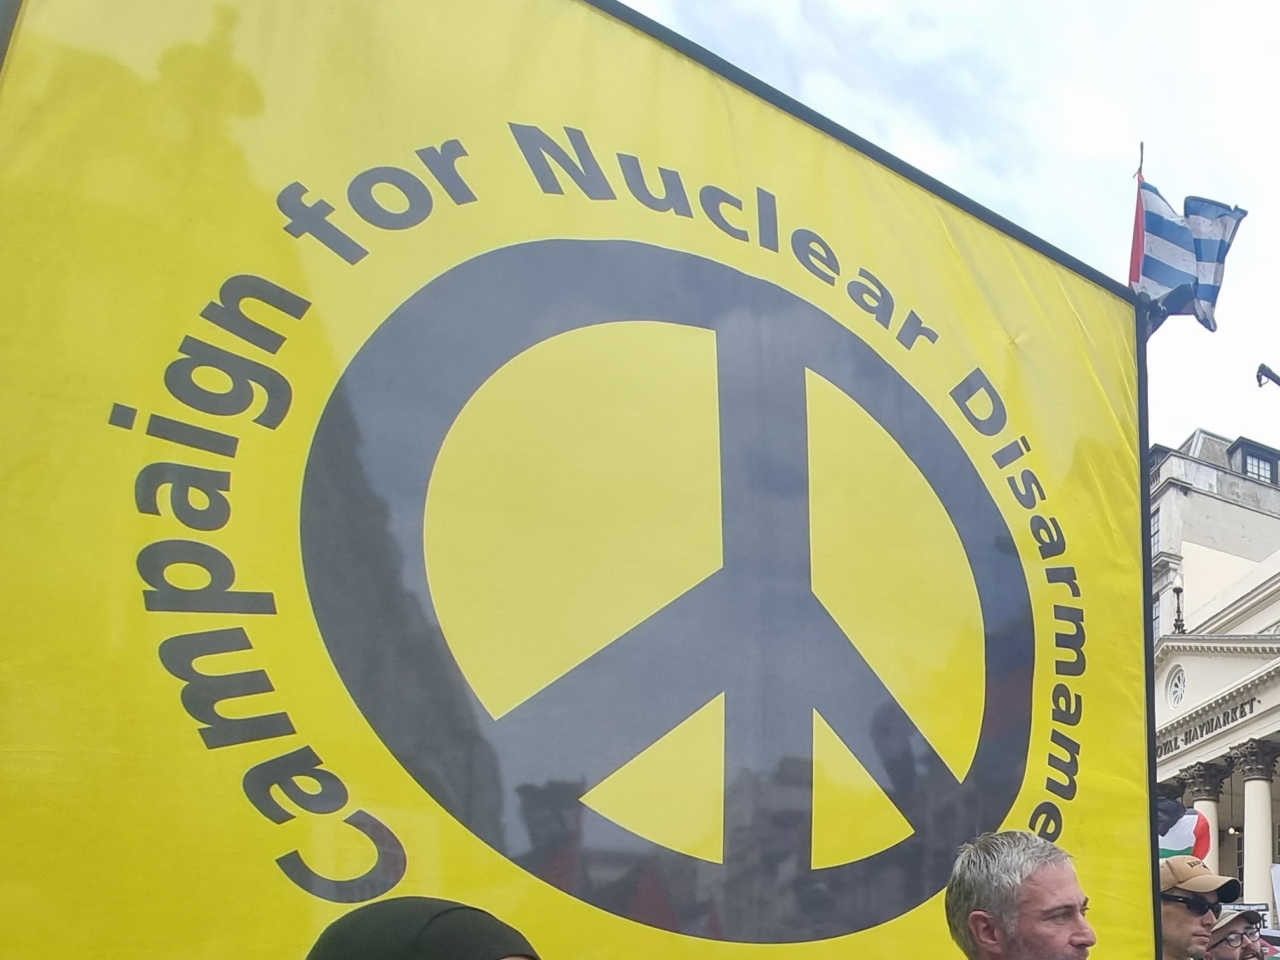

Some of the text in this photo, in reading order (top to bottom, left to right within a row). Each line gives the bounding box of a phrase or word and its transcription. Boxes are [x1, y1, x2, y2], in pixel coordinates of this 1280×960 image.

[109, 121, 1087, 905] Campaign for Nuclear Disarmame
[1156, 696, 1257, 758] OYAL HAYMARKET
